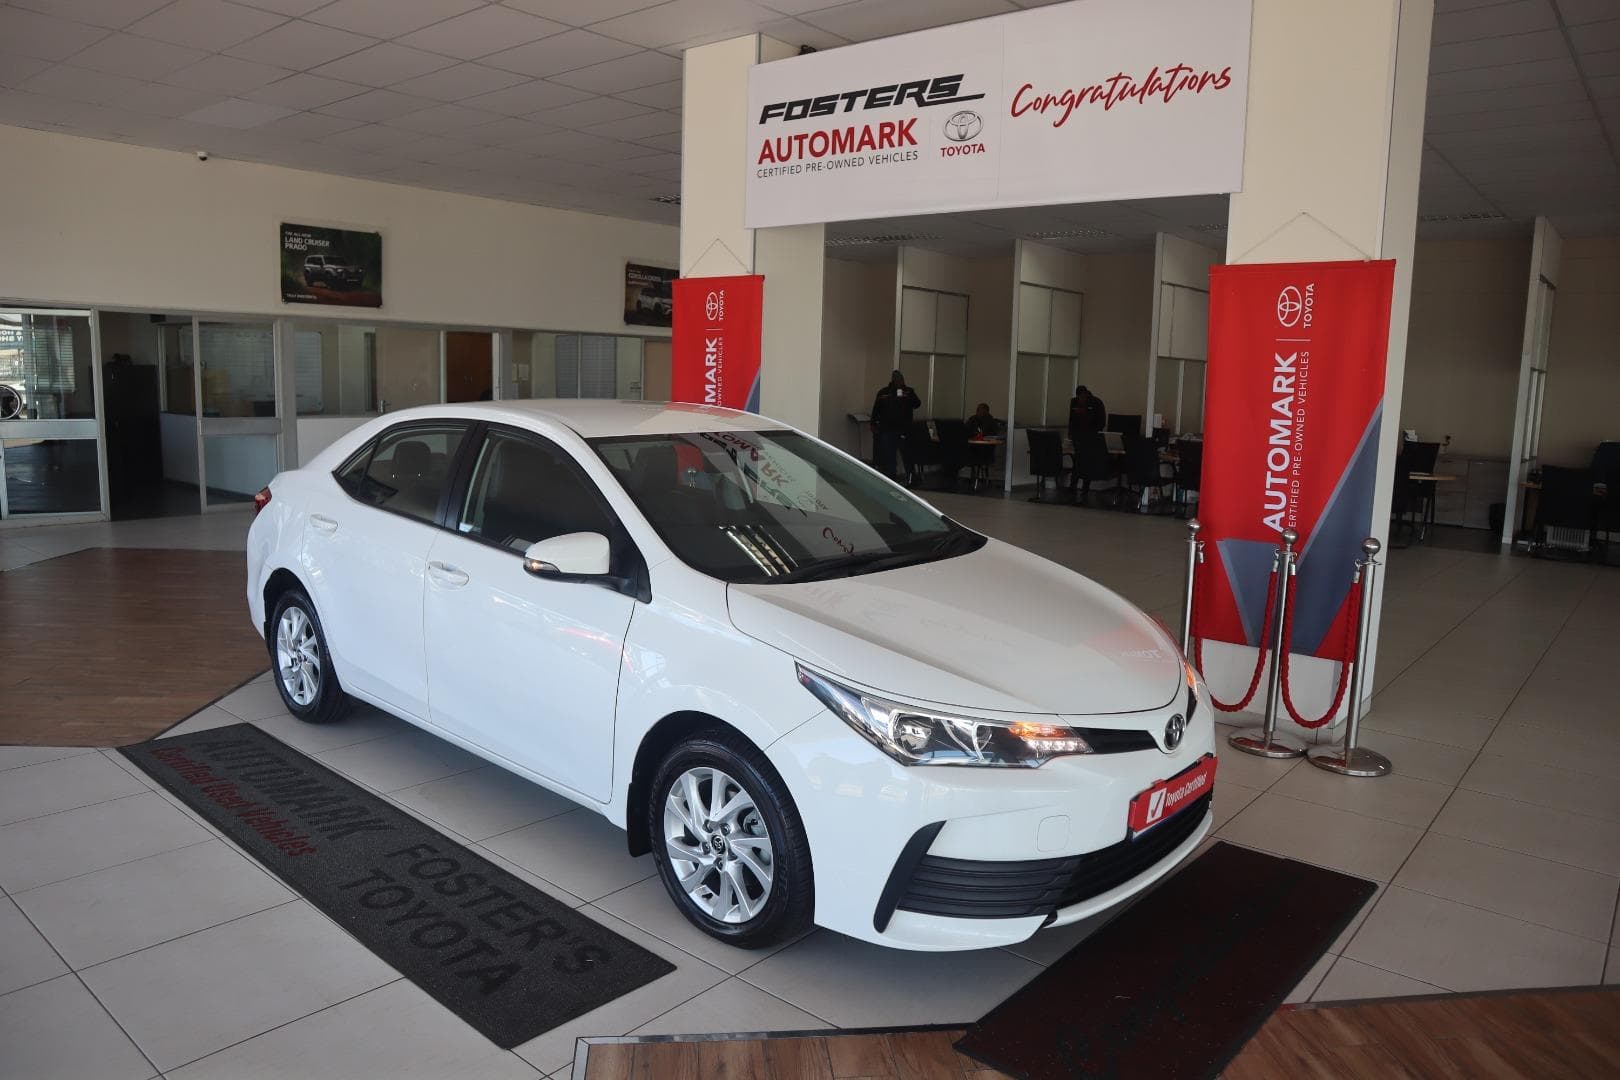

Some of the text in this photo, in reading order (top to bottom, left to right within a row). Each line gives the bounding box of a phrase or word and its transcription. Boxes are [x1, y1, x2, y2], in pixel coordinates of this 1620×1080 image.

[758, 74, 985, 125] FOSTERS
[1010, 63, 1232, 127] Congratulations
[757, 150, 919, 179] CERTIFIED PRE-OWNED VEHICLES
[758, 118, 918, 165] AUTOMARK
[940, 143, 986, 157] TOYOTA
[285, 236, 330, 247] LAND CRUISER
[285, 243, 307, 251] PRADO
[1304, 283, 1315, 328] TOYOTA
[1263, 352, 1297, 533] AUTOMARK
[1289, 351, 1309, 528] ERTIFIED PRE-OWNED VEHICLES
[338, 868, 522, 995] TOYOTA
